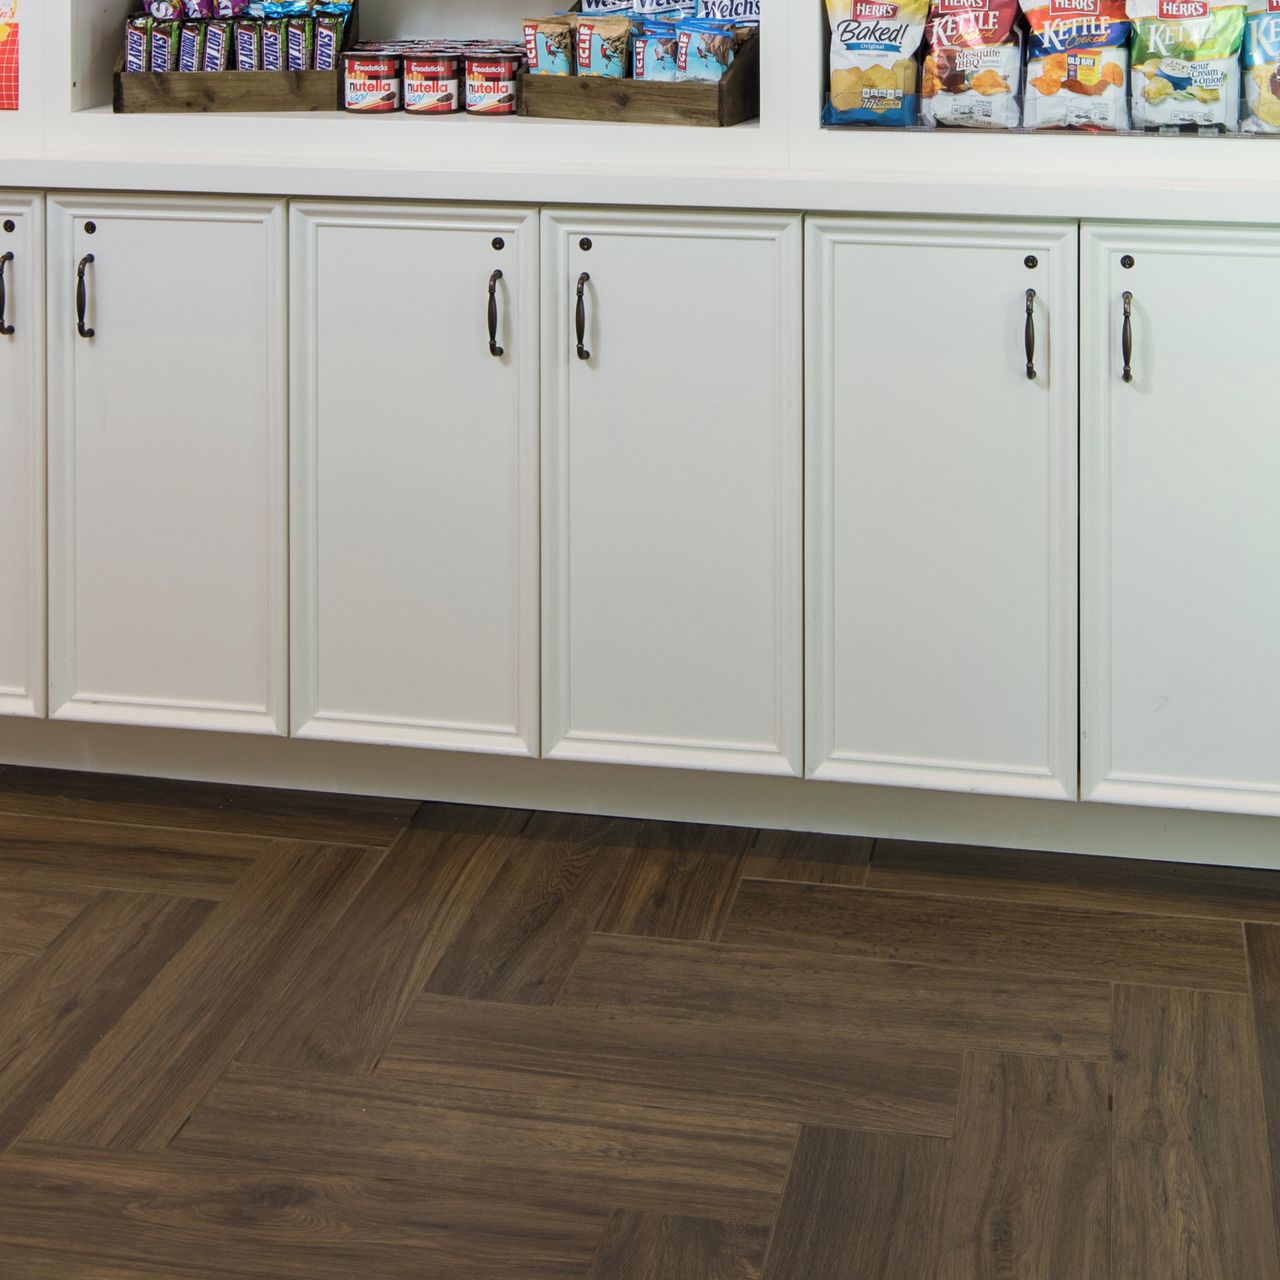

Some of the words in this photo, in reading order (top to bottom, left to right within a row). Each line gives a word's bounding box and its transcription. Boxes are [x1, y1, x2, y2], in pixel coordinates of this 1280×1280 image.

[855, 3, 896, 19] HERR'S
[1161, 0, 1205, 17] HERR'S
[836, 19, 910, 46] Baked!
[930, 10, 999, 47] KETTLE
[1041, 15, 1111, 51] KETTLE
[128, 31, 142, 60] CRAY
[207, 29, 222, 54] HOT
[239, 31, 254, 58] CRAY
[288, 30, 302, 53] HOT
[524, 25, 537, 57] CLIF
[579, 25, 591, 57] CLIF
[678, 34, 689, 62] CLIF
[860, 42, 886, 51] Original
[1064, 33, 1109, 50] Cooked
[635, 41, 645, 68] CLIF
[956, 48, 1002, 64] Mesquite
[1067, 55, 1081, 67] OLD
[1082, 56, 1096, 67] BAY
[956, 57, 981, 71] BBQ
[1189, 62, 1210, 73] Sour
[1190, 68, 1220, 79] Cream
[349, 80, 392, 93] nutella
[407, 80, 449, 94] nutella
[468, 82, 509, 94] nutella
